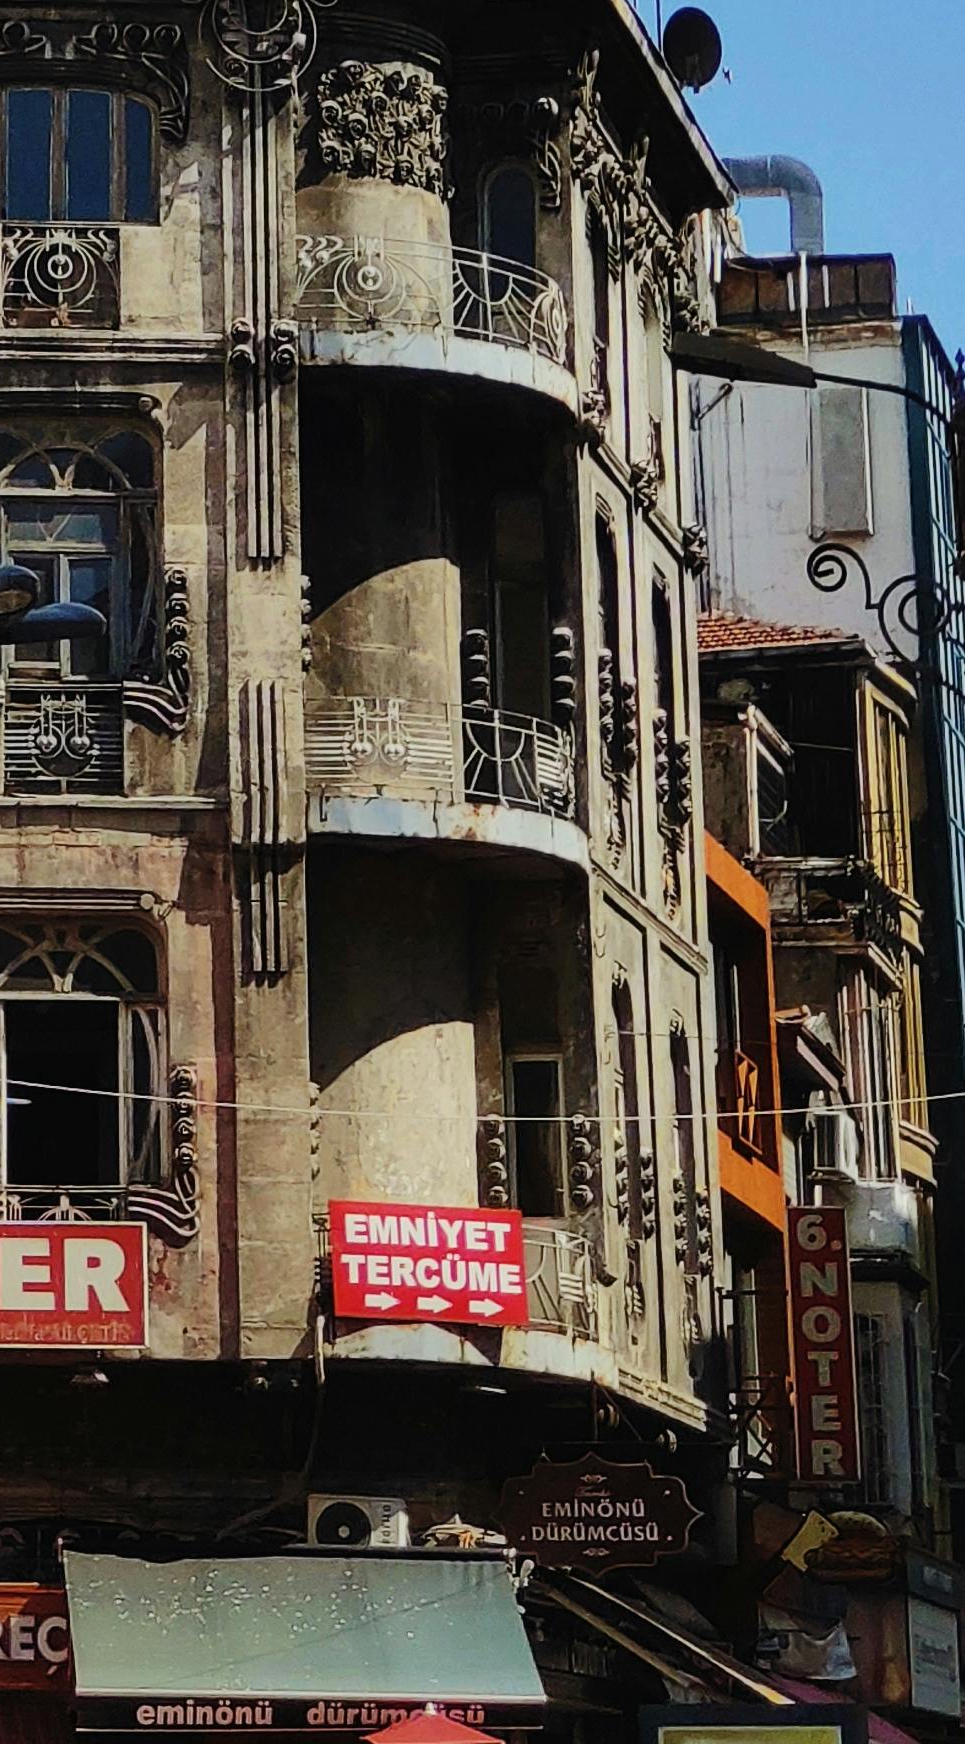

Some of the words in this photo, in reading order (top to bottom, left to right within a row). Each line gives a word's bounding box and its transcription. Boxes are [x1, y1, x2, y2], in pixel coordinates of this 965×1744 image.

[344, 1211, 511, 1252] EMNİYET
[340, 1253, 523, 1294] TERCÜME
[799, 1261, 846, 1476] NOTER
[541, 1498, 646, 1518] EMİNÖNÜ
[531, 1522, 659, 1542] DÜRÜMCÜSÜ
[136, 1699, 274, 1726] eminönü
